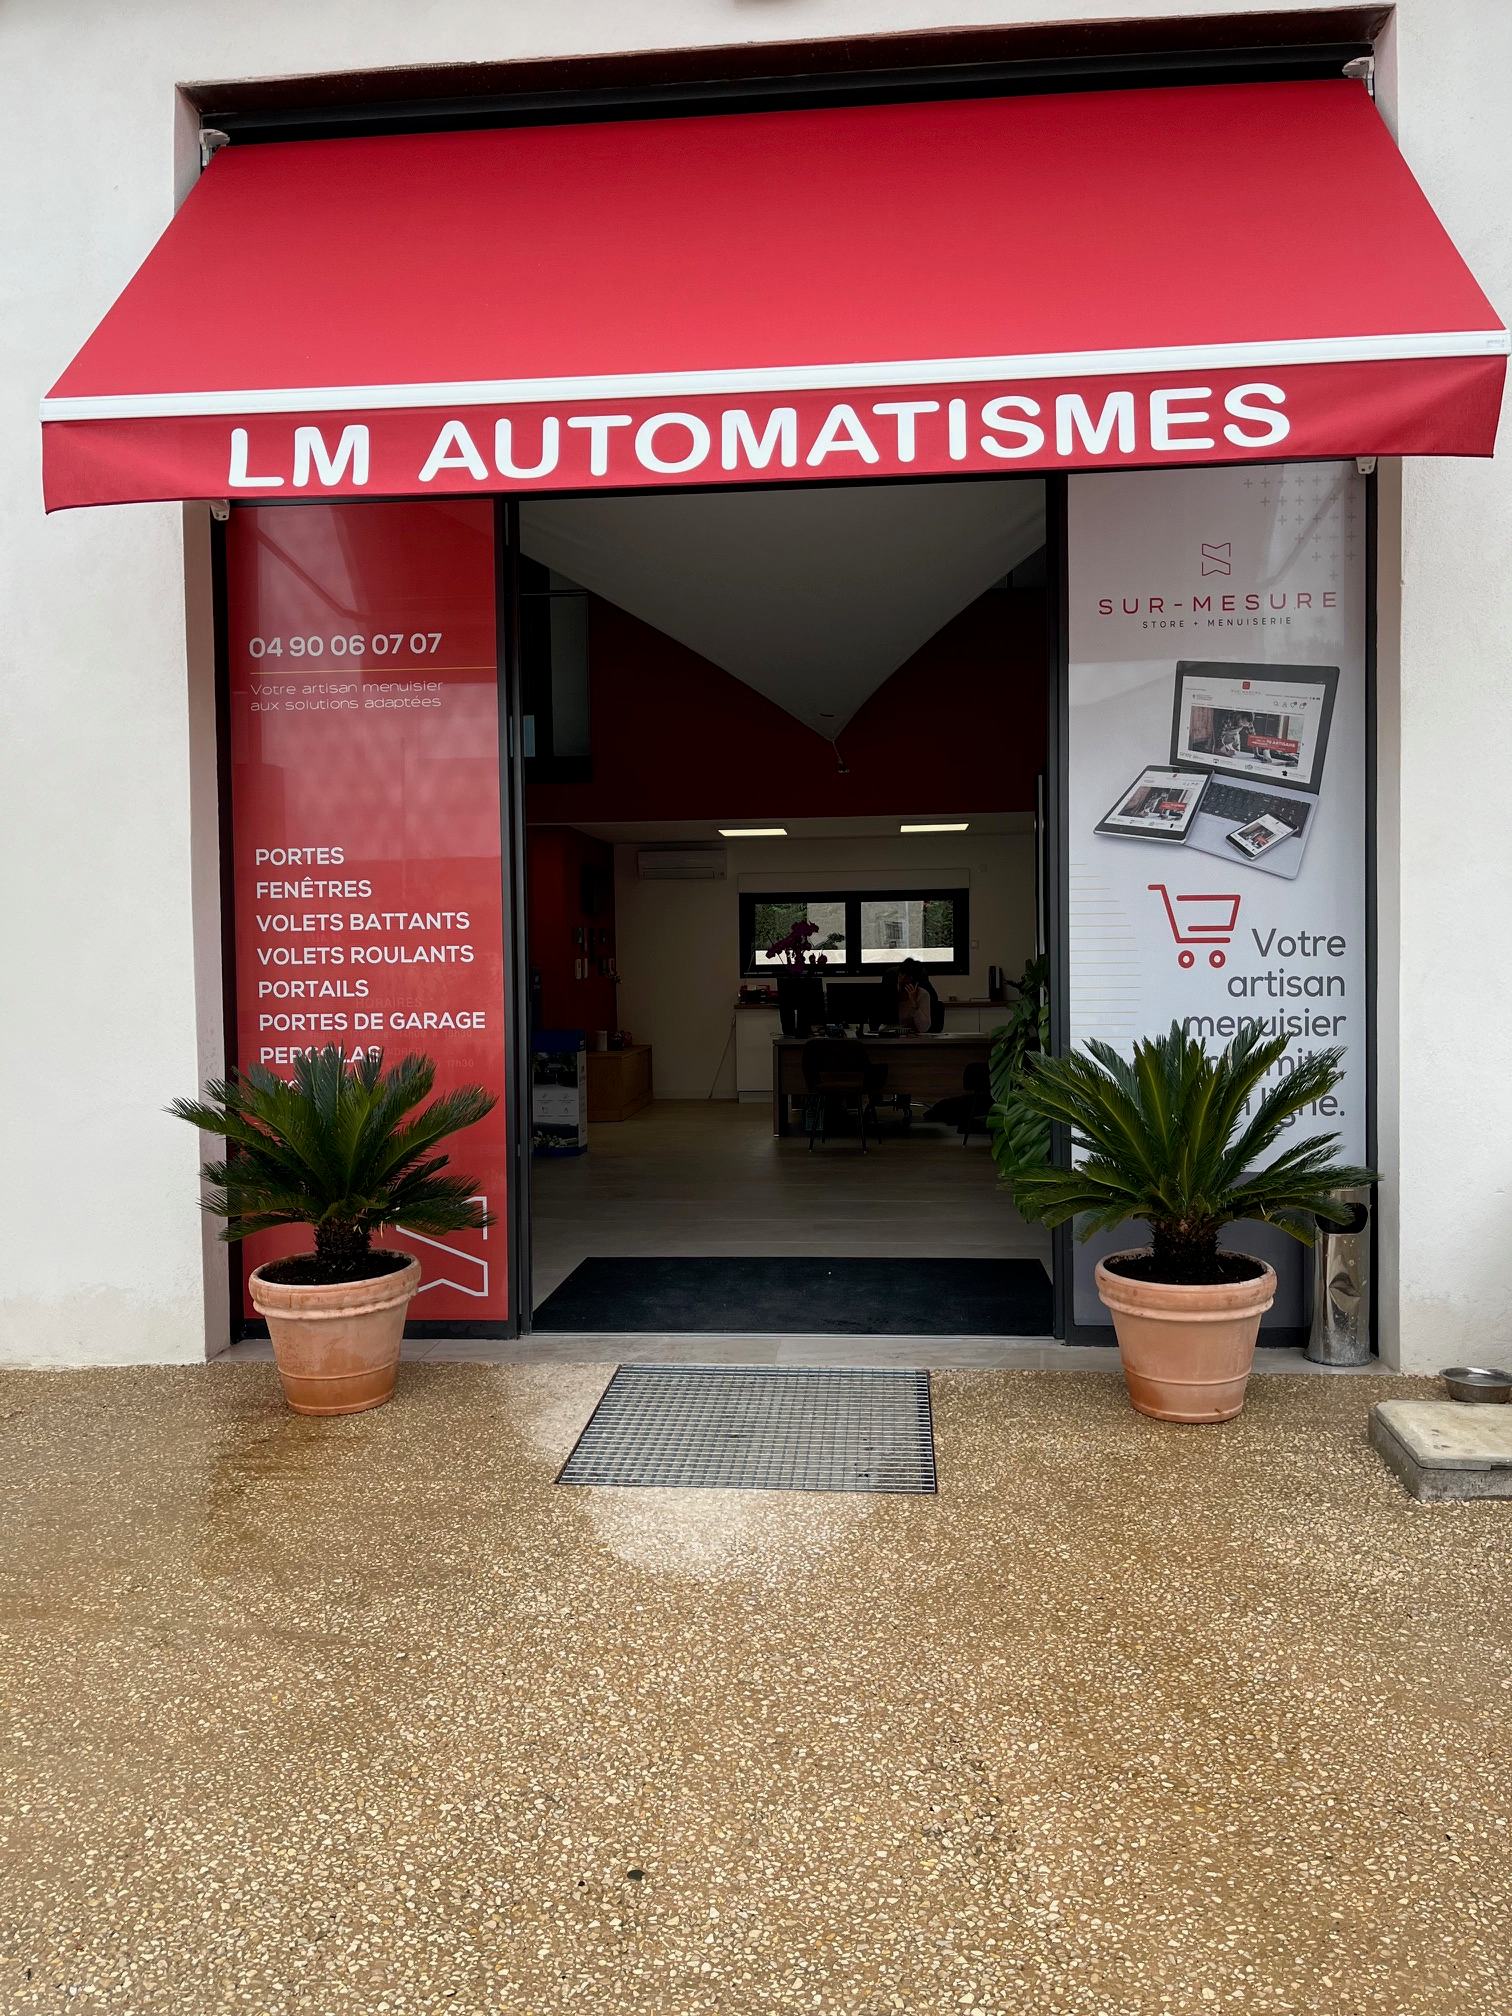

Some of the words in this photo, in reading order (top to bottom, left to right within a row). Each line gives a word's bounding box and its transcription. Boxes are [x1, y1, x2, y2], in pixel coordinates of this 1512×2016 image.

[228, 424, 369, 487] LM
[418, 382, 1291, 482] AUTOMATISMES
[1099, 592, 1337, 615] SUR-MESURE
[1142, 620, 1185, 629] STORE
[1207, 617, 1292, 627] MENUISERIE
[249, 637, 283, 658] 04
[289, 636, 324, 657] 90
[330, 635, 365, 656] 06
[371, 634, 404, 655] 07
[409, 633, 443, 654] 07
[250, 684, 296, 696] Votre
[301, 682, 358, 695] artisan
[362, 681, 443, 693] menuisier
[250, 701, 280, 711] aux
[285, 699, 359, 711] solutions
[364, 695, 442, 709] adaptées
[255, 847, 345, 866] PORTES
[256, 876, 372, 899] FENÊTRES
[256, 914, 344, 932] VOLETS
[350, 912, 470, 931] BATTANTS
[1251, 928, 1346, 957] Votre
[257, 947, 344, 965] VOLETS
[351, 945, 475, 964] ROULANTS
[258, 980, 369, 998] PORTAILS
[1227, 968, 1346, 998] artisan
[259, 1013, 348, 1031] PORTES
[354, 1012, 384, 1030] DE
[389, 1011, 486, 1030] GARAGE
[1186, 1008, 1347, 1038] menuisier
